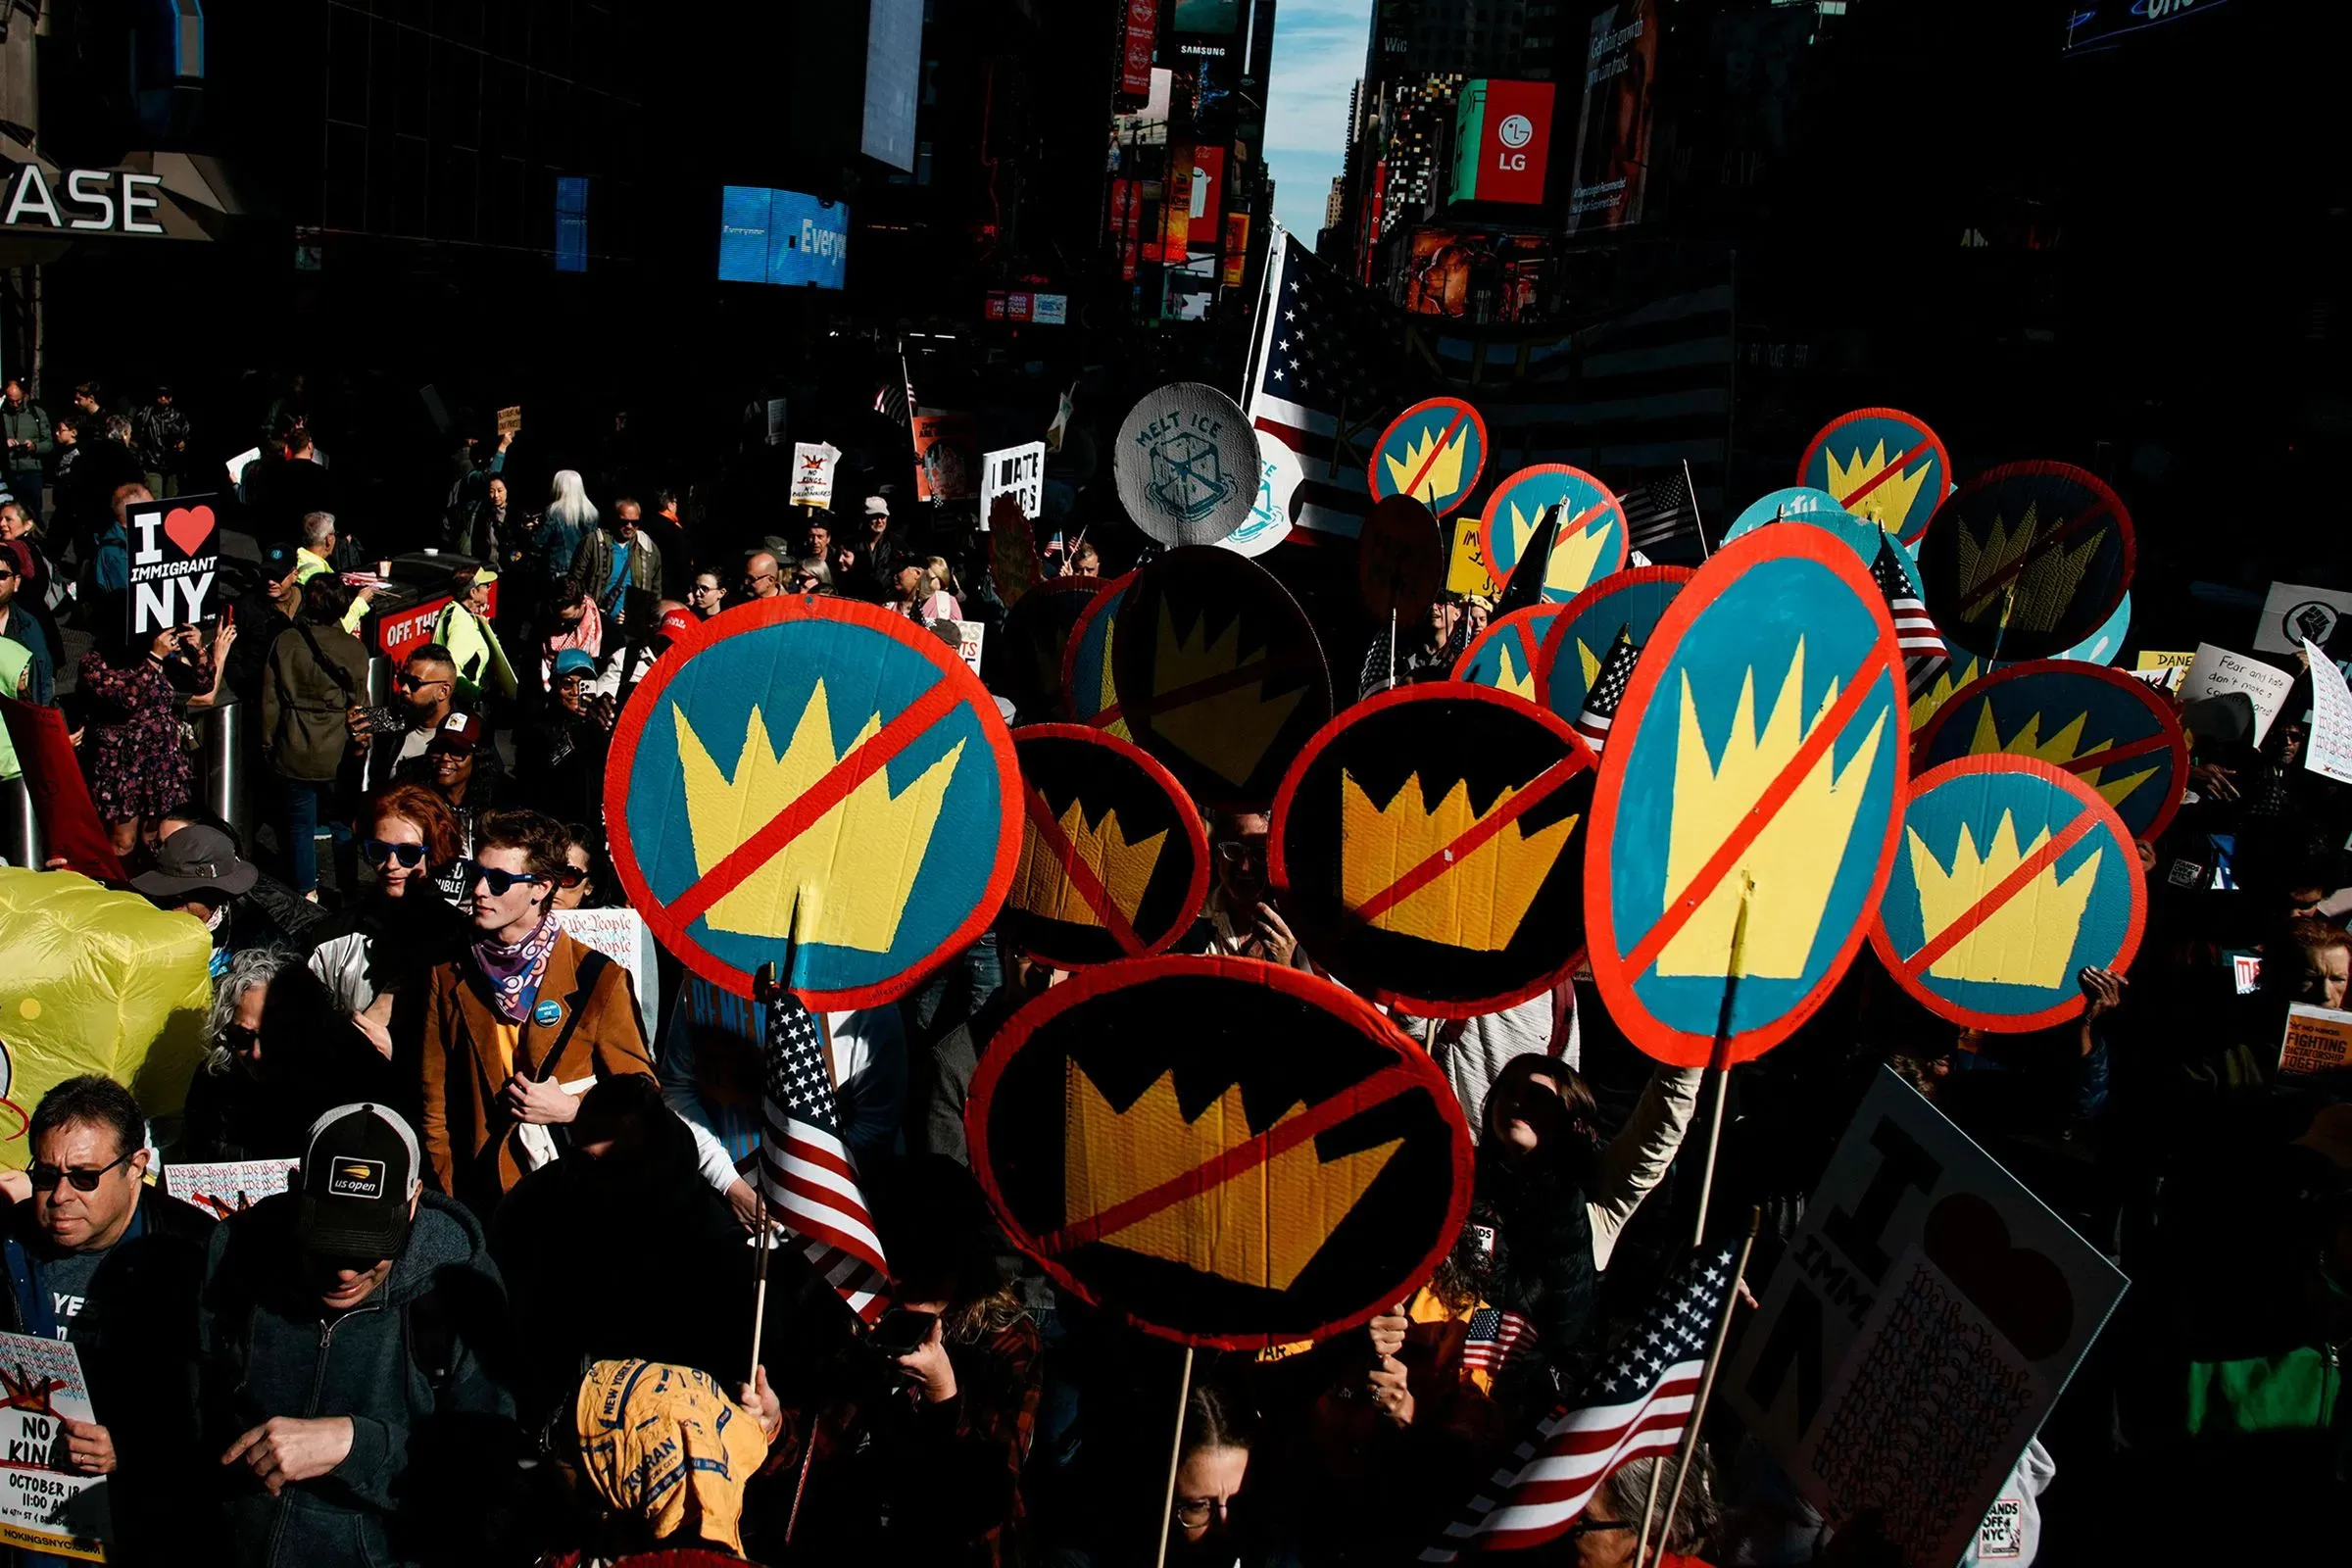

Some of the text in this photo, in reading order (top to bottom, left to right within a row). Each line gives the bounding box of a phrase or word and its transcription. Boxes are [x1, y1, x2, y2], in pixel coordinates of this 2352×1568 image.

[1180, 45, 1225, 56] SAMSUNG
[1498, 153, 1527, 171] LG
[1136, 411, 1223, 447] MELT ICE
[134, 512, 163, 565] I
[130, 556, 218, 582] IMMIGRANT
[135, 571, 216, 633] NY
[2219, 655, 2247, 673] Fear
[2249, 669, 2267, 683] and
[2208, 671, 2238, 685] don't
[2241, 682, 2264, 696] make
[587, 912, 631, 934] People
[2284, 1045, 2345, 1062] DICTATORSHIP
[2286, 1032, 2347, 1054] FIGHTING
[2283, 1054, 2341, 1072] TOGETHE
[203, 1164, 239, 1178] People
[334, 1179, 376, 1193] us open
[604, 1388, 617, 1414] NEW
[23, 1416, 51, 1441] NO
[8, 1439, 47, 1467] KIN
[9, 1473, 80, 1499] OCTOBER 18
[23, 1493, 47, 1508] 11:00
[1989, 1502, 2018, 1515] ANDS
[24, 1511, 32, 1520] ST
[1983, 1516, 2003, 1528] OFF
[1982, 1529, 2004, 1542] NYC
